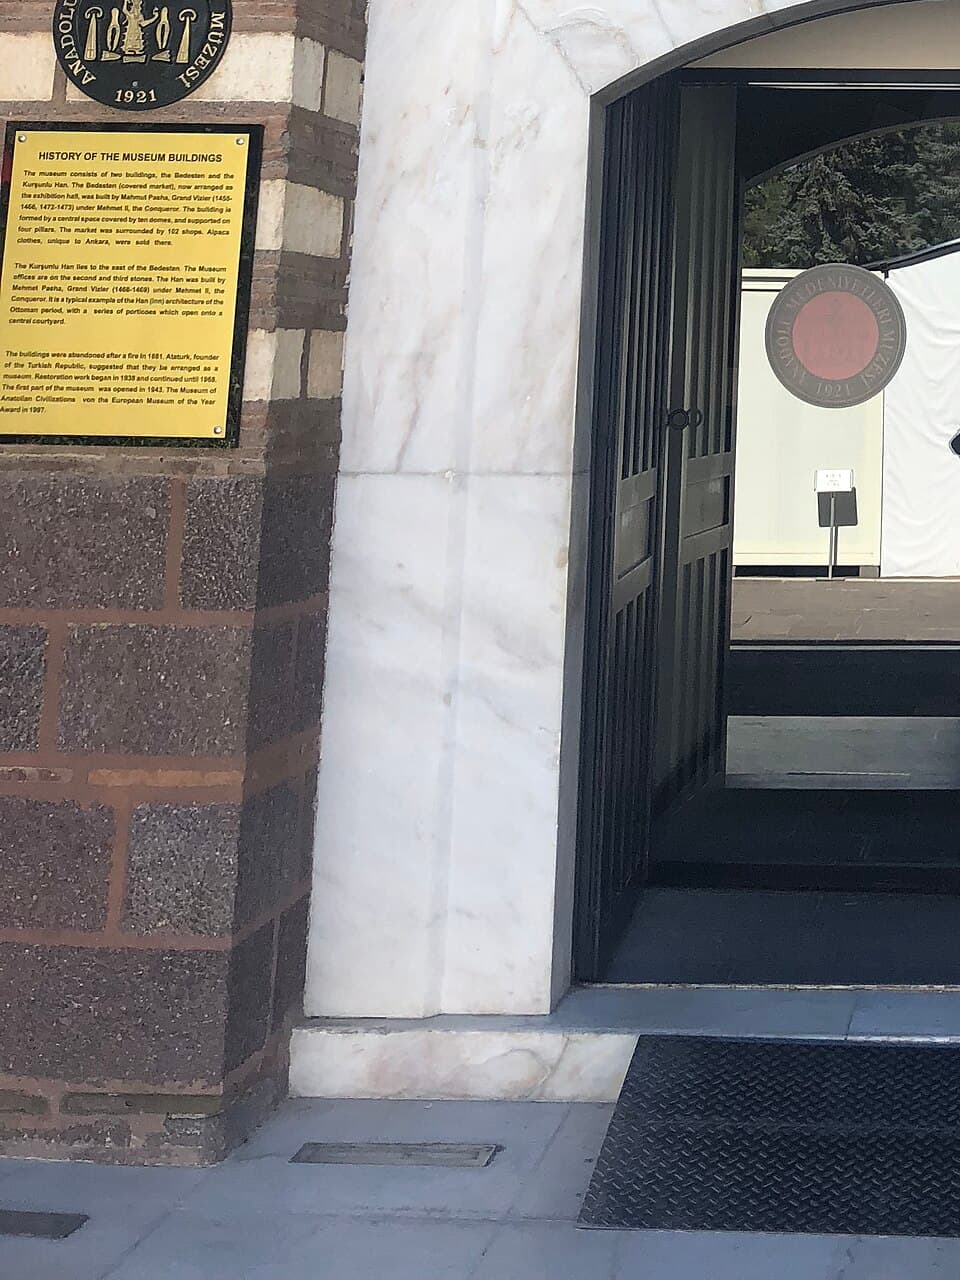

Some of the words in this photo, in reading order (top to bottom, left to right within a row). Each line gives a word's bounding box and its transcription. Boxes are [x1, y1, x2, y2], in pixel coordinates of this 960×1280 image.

[176, 11, 226, 88] MÜZESİ
[114, 90, 157, 102] 1921
[39, 152, 82, 160] HISTORY
[100, 153, 119, 161] THE
[122, 153, 165, 161] MUSEUM
[168, 154, 222, 162] BUILDINGS
